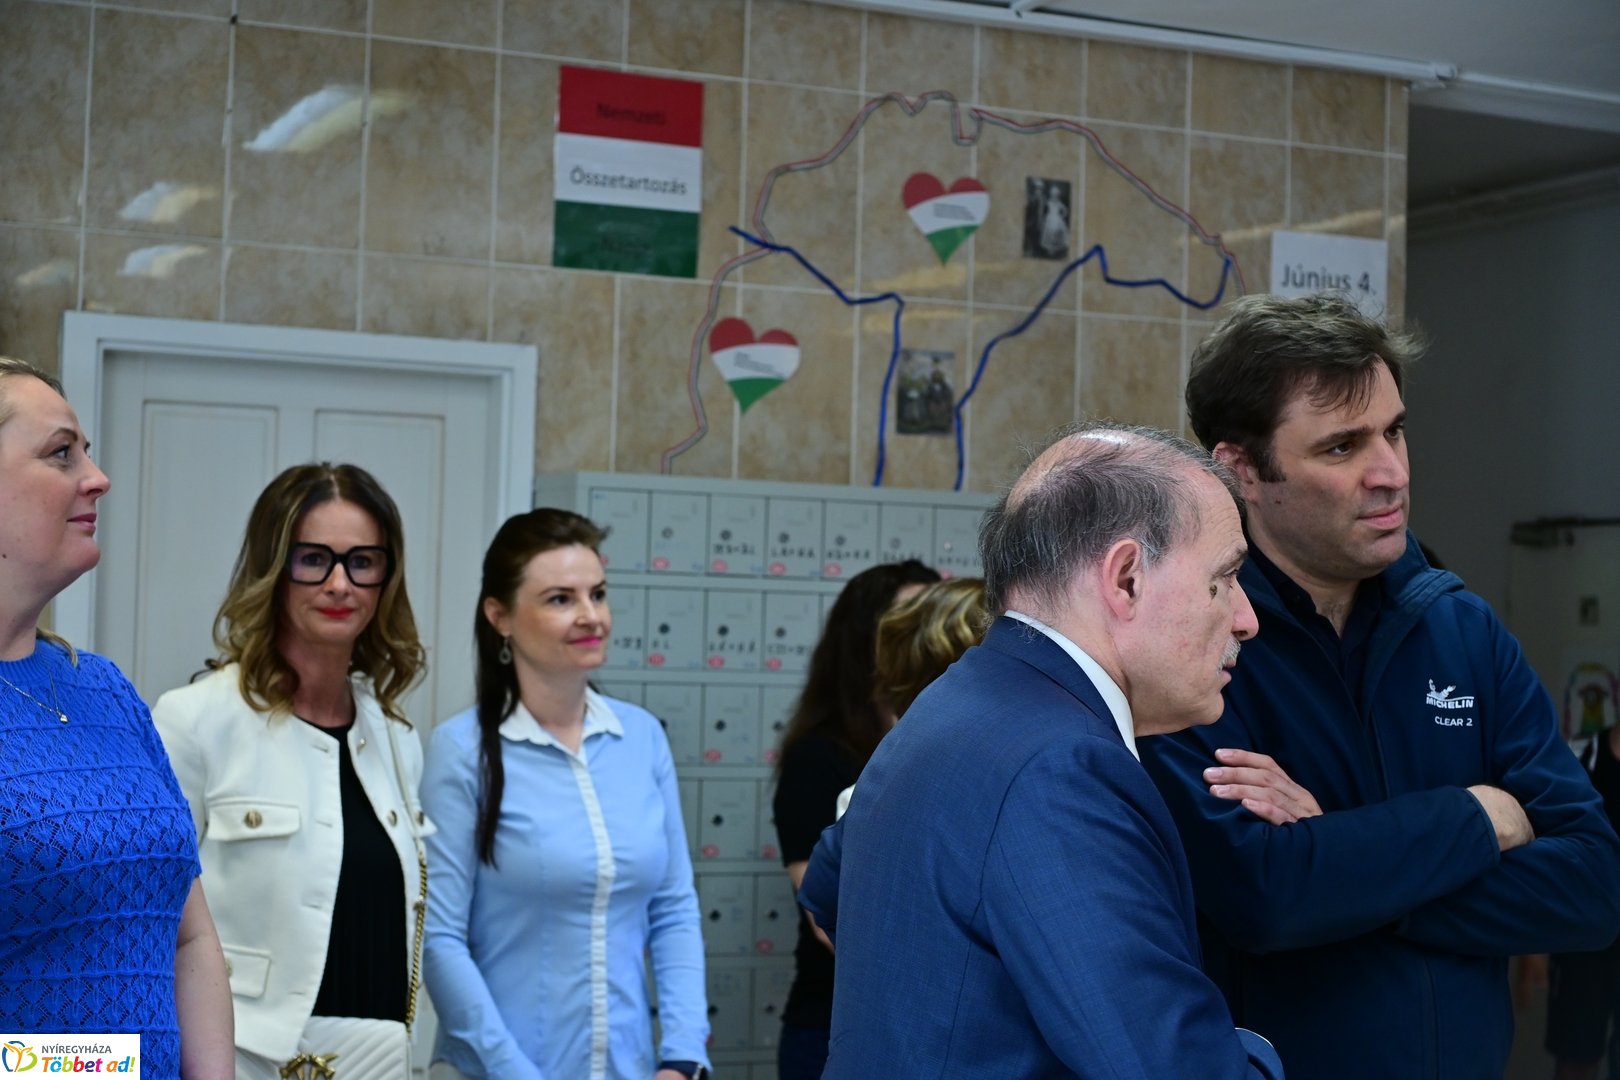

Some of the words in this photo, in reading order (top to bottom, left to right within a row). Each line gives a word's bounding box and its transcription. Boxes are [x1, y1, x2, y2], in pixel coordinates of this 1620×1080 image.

[570, 165, 687, 196] Összetartozás
[1281, 263, 1351, 289] Június
[1426, 696, 1474, 709] MICHELIN
[1434, 716, 1463, 727] CLEAR
[1466, 717, 1473, 727] 2
